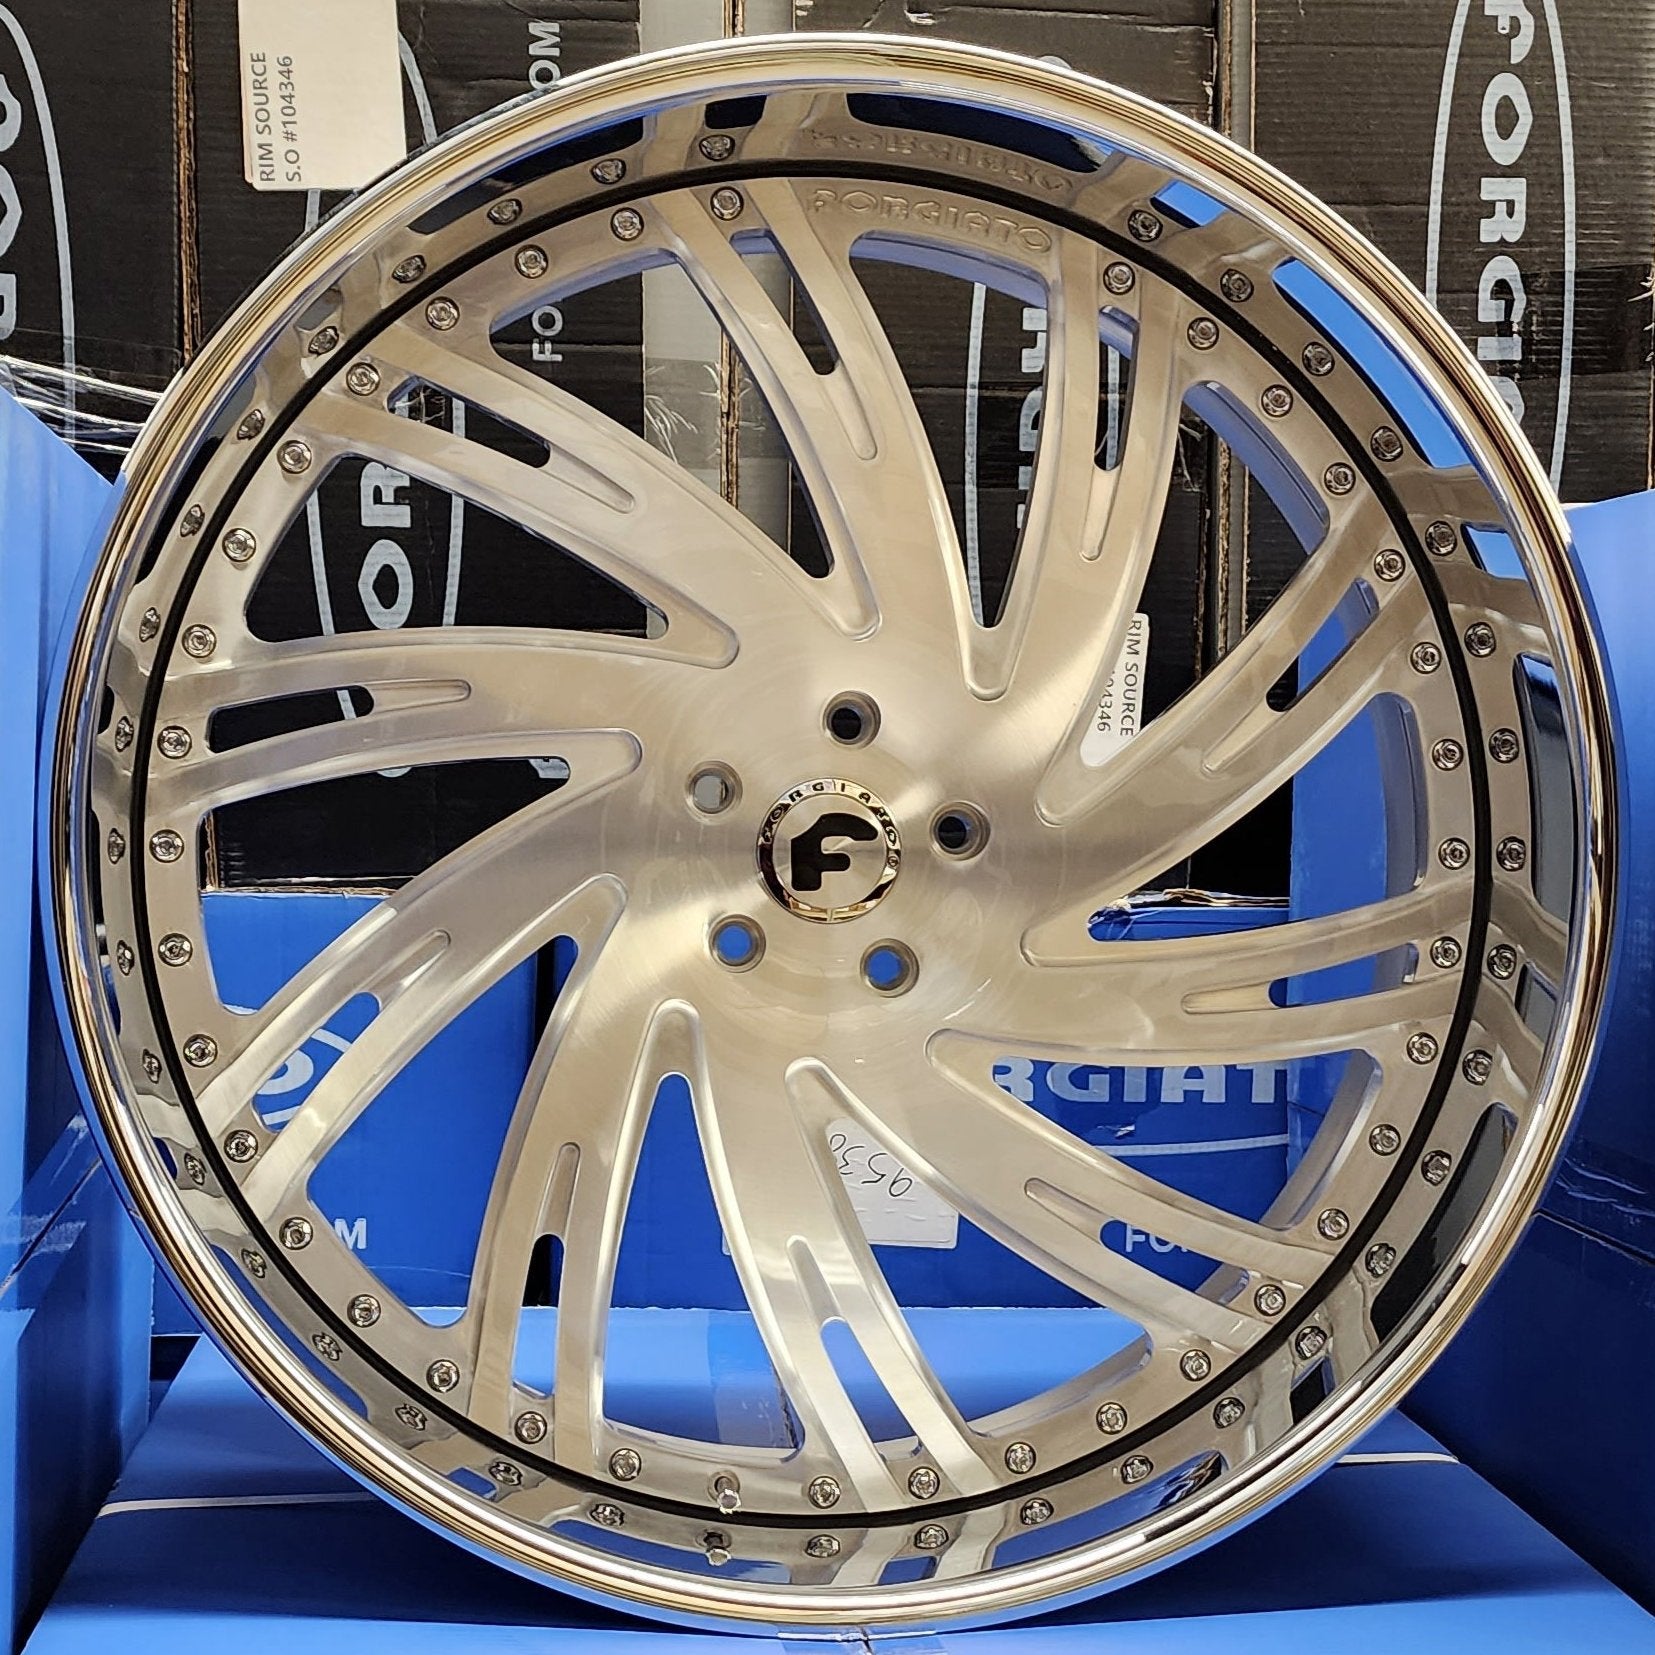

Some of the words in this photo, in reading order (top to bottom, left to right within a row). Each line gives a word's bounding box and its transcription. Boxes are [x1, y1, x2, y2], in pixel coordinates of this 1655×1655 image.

[250, 52, 272, 135] SOURCE
[277, 55, 298, 142] #104346
[257, 142, 276, 182] RIM
[284, 149, 301, 182] S.O
[806, 188, 1053, 253] FORGIATO
[1126, 620, 1142, 655] RIM
[1119, 661, 1140, 737] SOURCE
[791, 813, 879, 891] F
